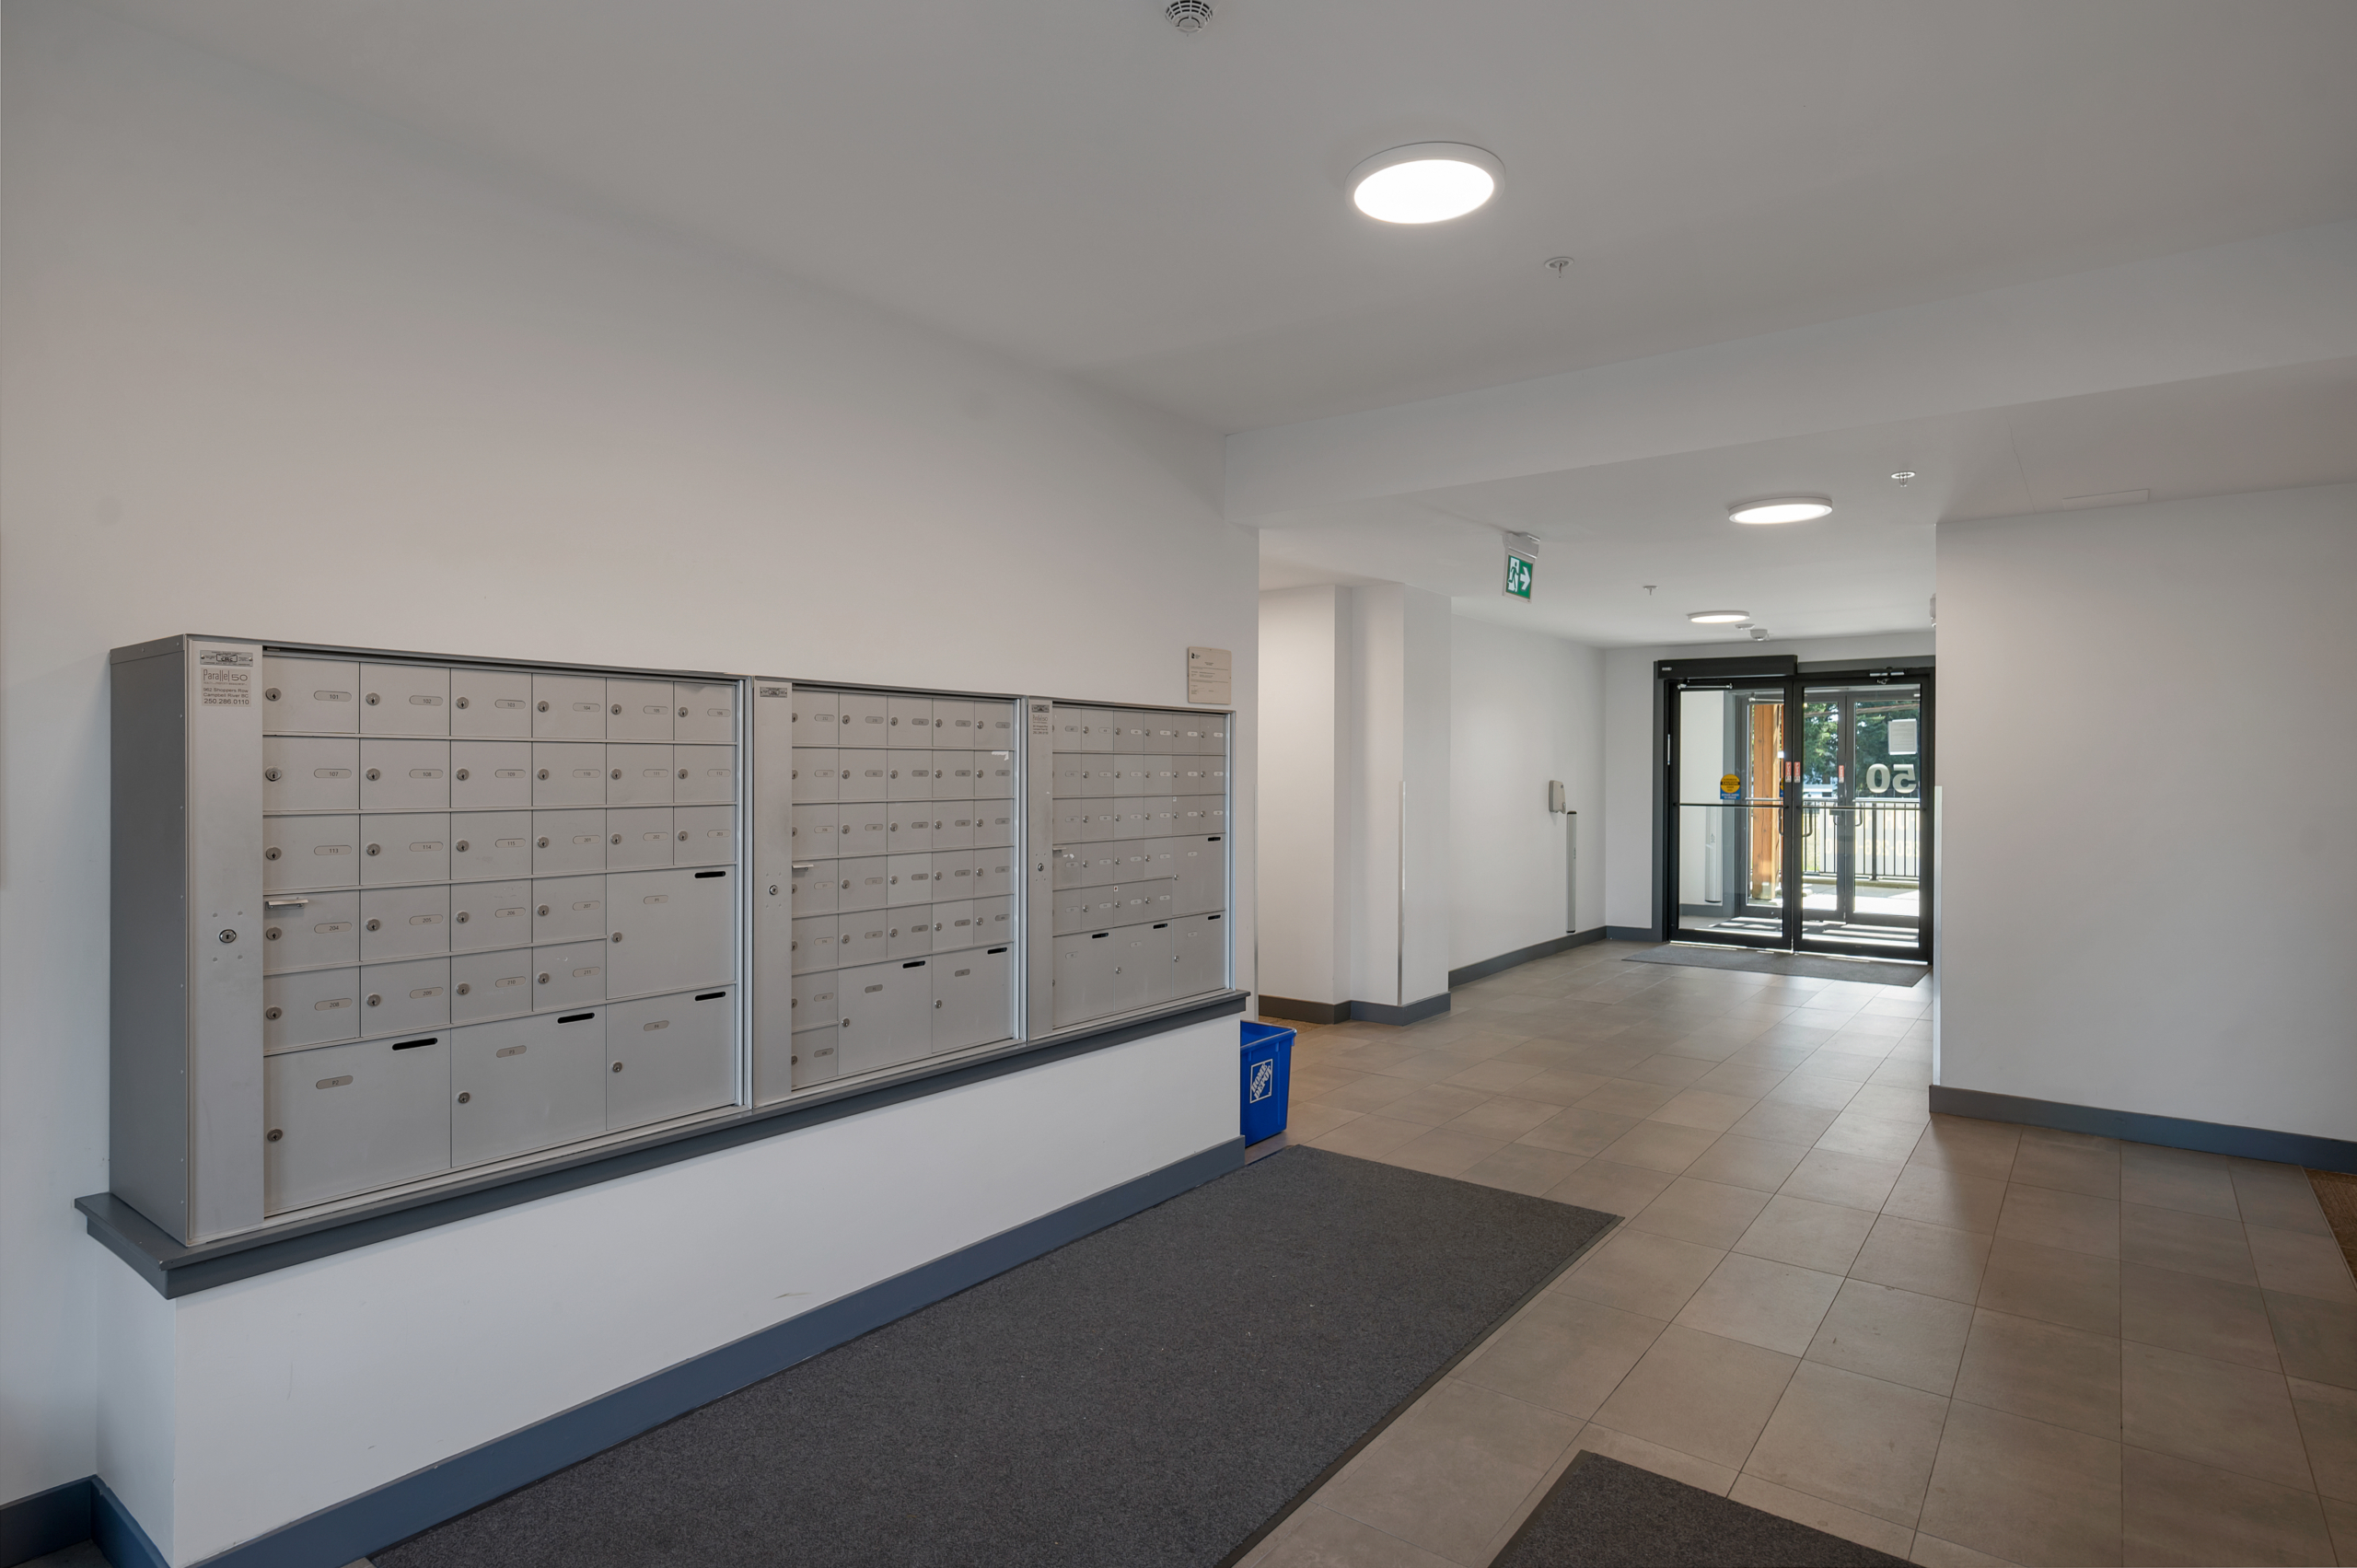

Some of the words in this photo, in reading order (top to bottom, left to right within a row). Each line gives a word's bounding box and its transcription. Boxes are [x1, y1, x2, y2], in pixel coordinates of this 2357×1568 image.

[203, 668, 230, 682] Parallel
[231, 673, 249, 681] 50
[1252, 1062, 1268, 1093] HOME
[1253, 1064, 1271, 1100] DEPOT
